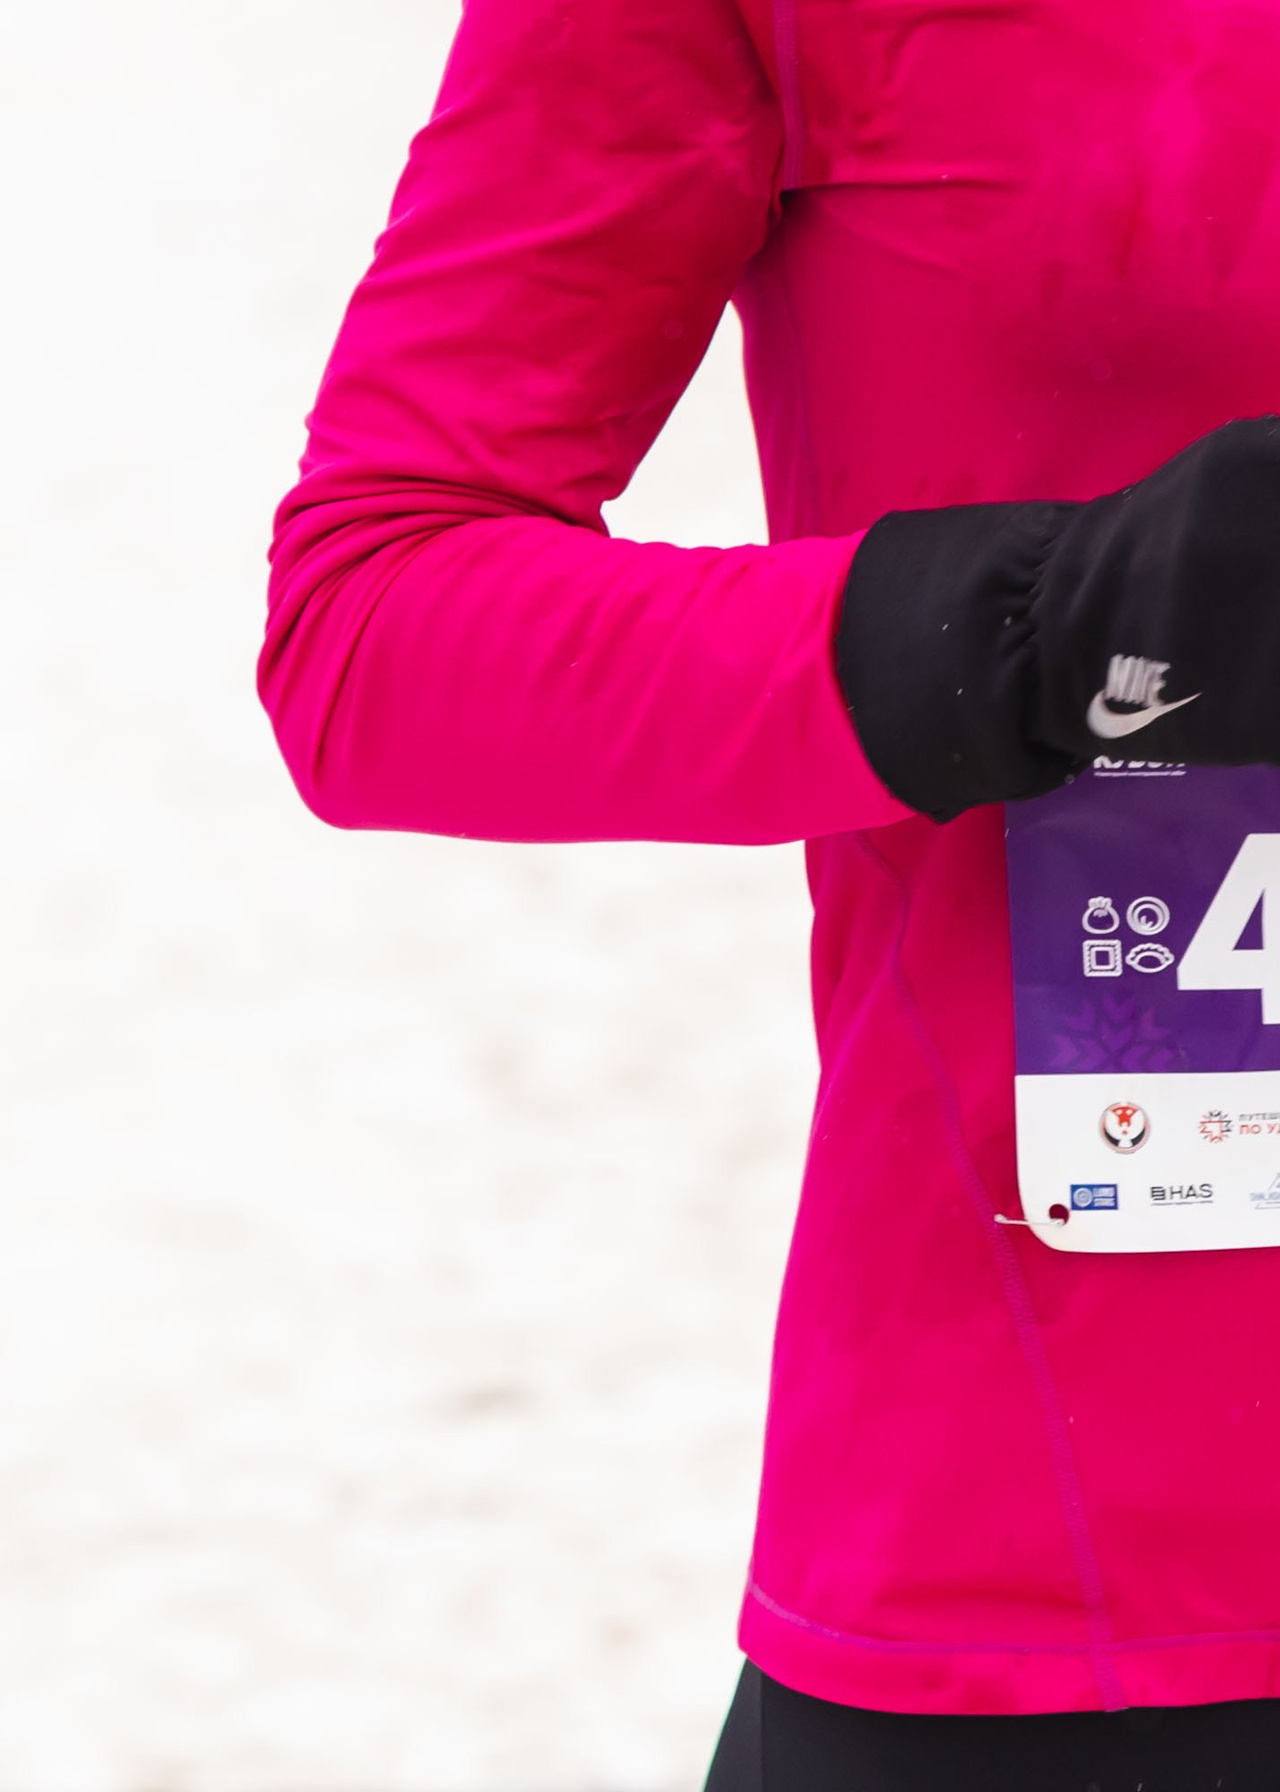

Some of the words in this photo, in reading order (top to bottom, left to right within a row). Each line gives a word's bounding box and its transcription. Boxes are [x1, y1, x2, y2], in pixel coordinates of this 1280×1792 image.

[1105, 654, 1171, 708] NIKE
[1238, 1123, 1263, 1136] ПО
[1169, 1182, 1214, 1201] HAS
